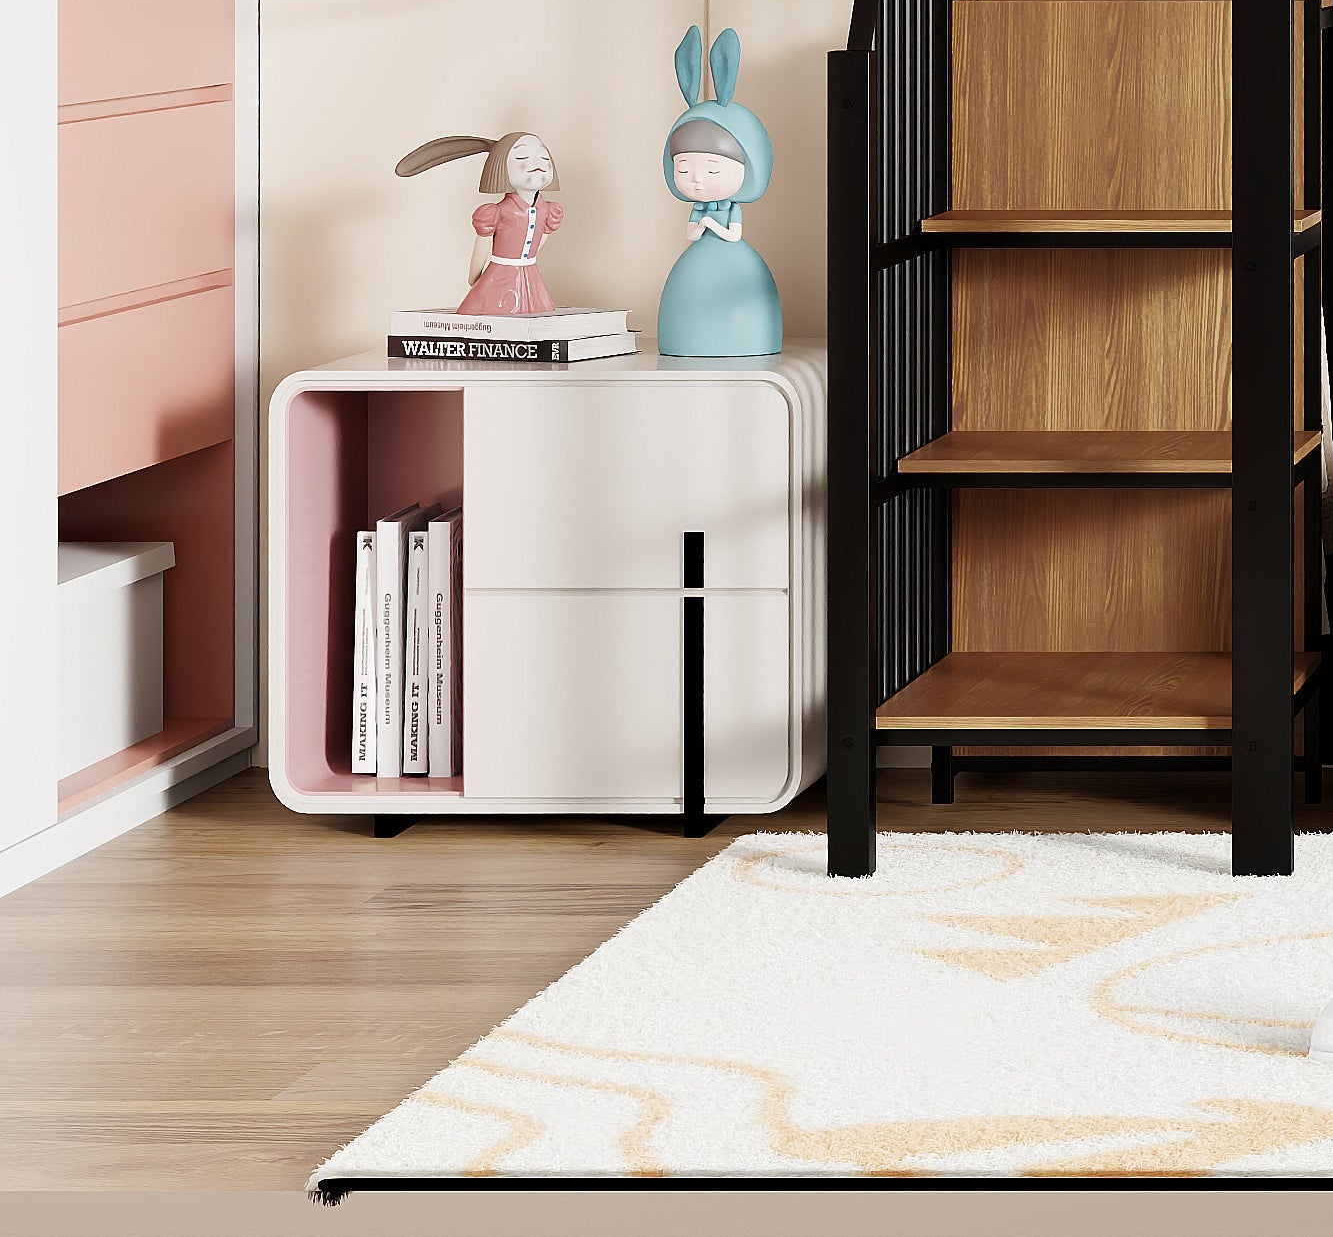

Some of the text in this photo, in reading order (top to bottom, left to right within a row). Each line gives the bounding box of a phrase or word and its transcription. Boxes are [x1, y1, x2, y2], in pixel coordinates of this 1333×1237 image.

[401, 339, 538, 360] WALTER FINANCE
[383, 593, 392, 725] Guggenheim Museum
[435, 593, 444, 670] Guggenheim
[360, 683, 368, 698] IT
[411, 683, 419, 698] IT
[358, 701, 368, 761] MAKING
[410, 701, 419, 761] MAKING
